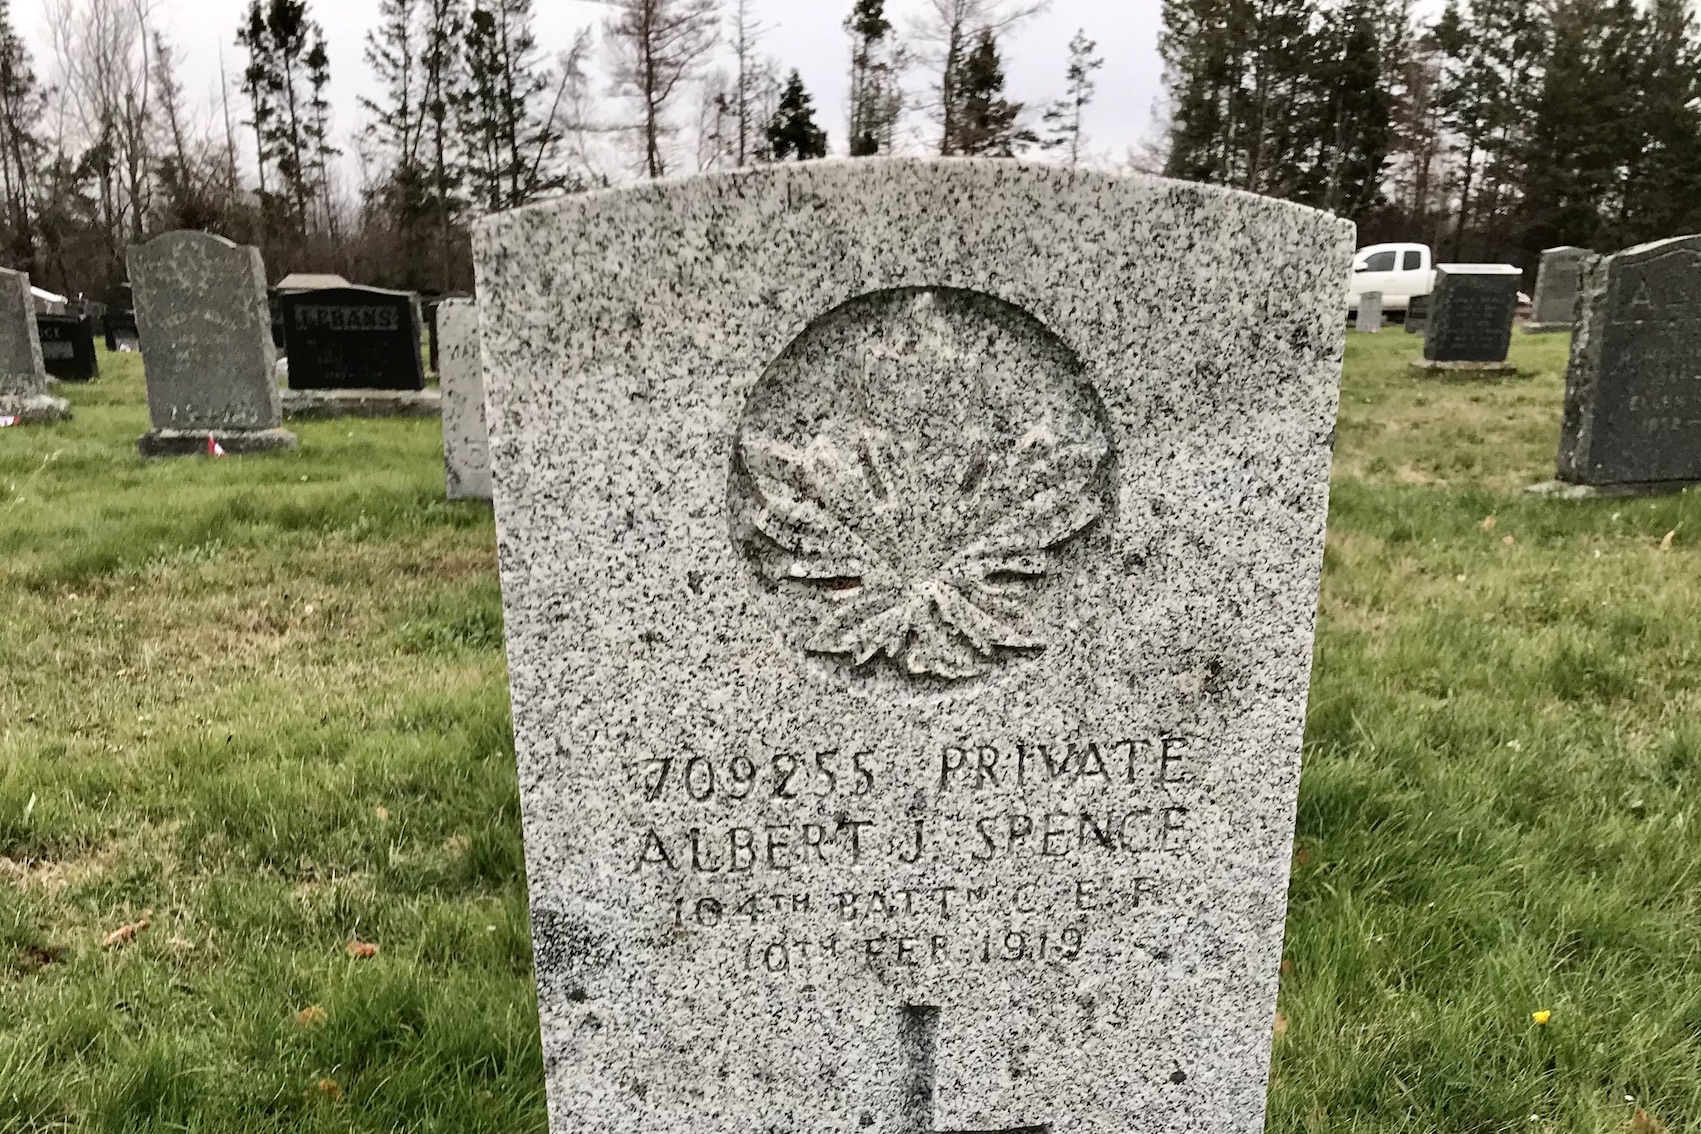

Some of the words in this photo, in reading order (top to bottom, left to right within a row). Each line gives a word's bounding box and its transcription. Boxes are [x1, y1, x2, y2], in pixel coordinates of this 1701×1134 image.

[631, 750, 875, 801] 709255
[936, 737, 1187, 791] PRIVATE
[632, 820, 874, 872] ALBERT
[971, 806, 1189, 861] SPENCE
[981, 927, 1083, 963] 1919
